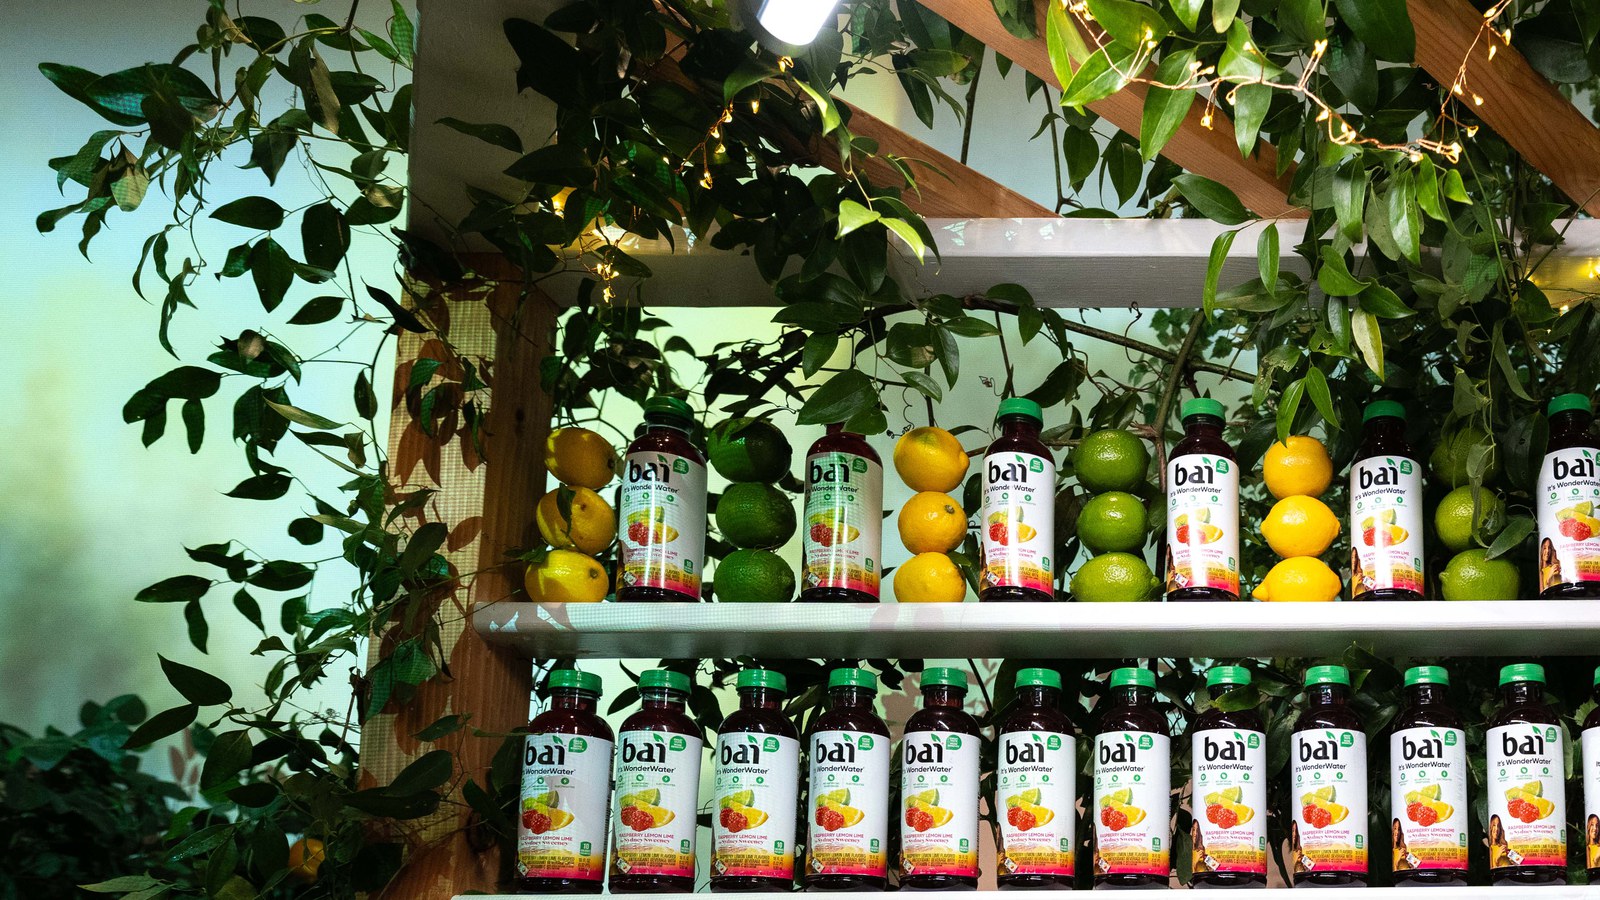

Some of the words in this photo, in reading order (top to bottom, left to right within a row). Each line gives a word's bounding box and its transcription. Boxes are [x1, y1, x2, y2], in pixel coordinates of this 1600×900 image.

[629, 454, 669, 483] bai
[810, 455, 849, 484] bai
[989, 454, 1027, 484] bai
[1175, 457, 1213, 486] bai
[1360, 458, 1398, 489] bai
[1553, 450, 1594, 480] bai
[631, 485, 678, 494] WondeWater
[990, 485, 1034, 493] WondeWater
[1363, 488, 1406, 497] WonderWater
[1557, 480, 1600, 489] WonderWate
[525, 736, 565, 766] bai
[623, 733, 665, 763] bai
[721, 735, 759, 765] bai
[816, 733, 854, 763] bai
[906, 734, 942, 764] bai
[1006, 734, 1044, 764] bai
[1100, 734, 1135, 765] bai
[1204, 732, 1245, 761] bai
[1300, 731, 1338, 762] bai
[1403, 730, 1442, 760] bai
[1503, 726, 1543, 757] bai
